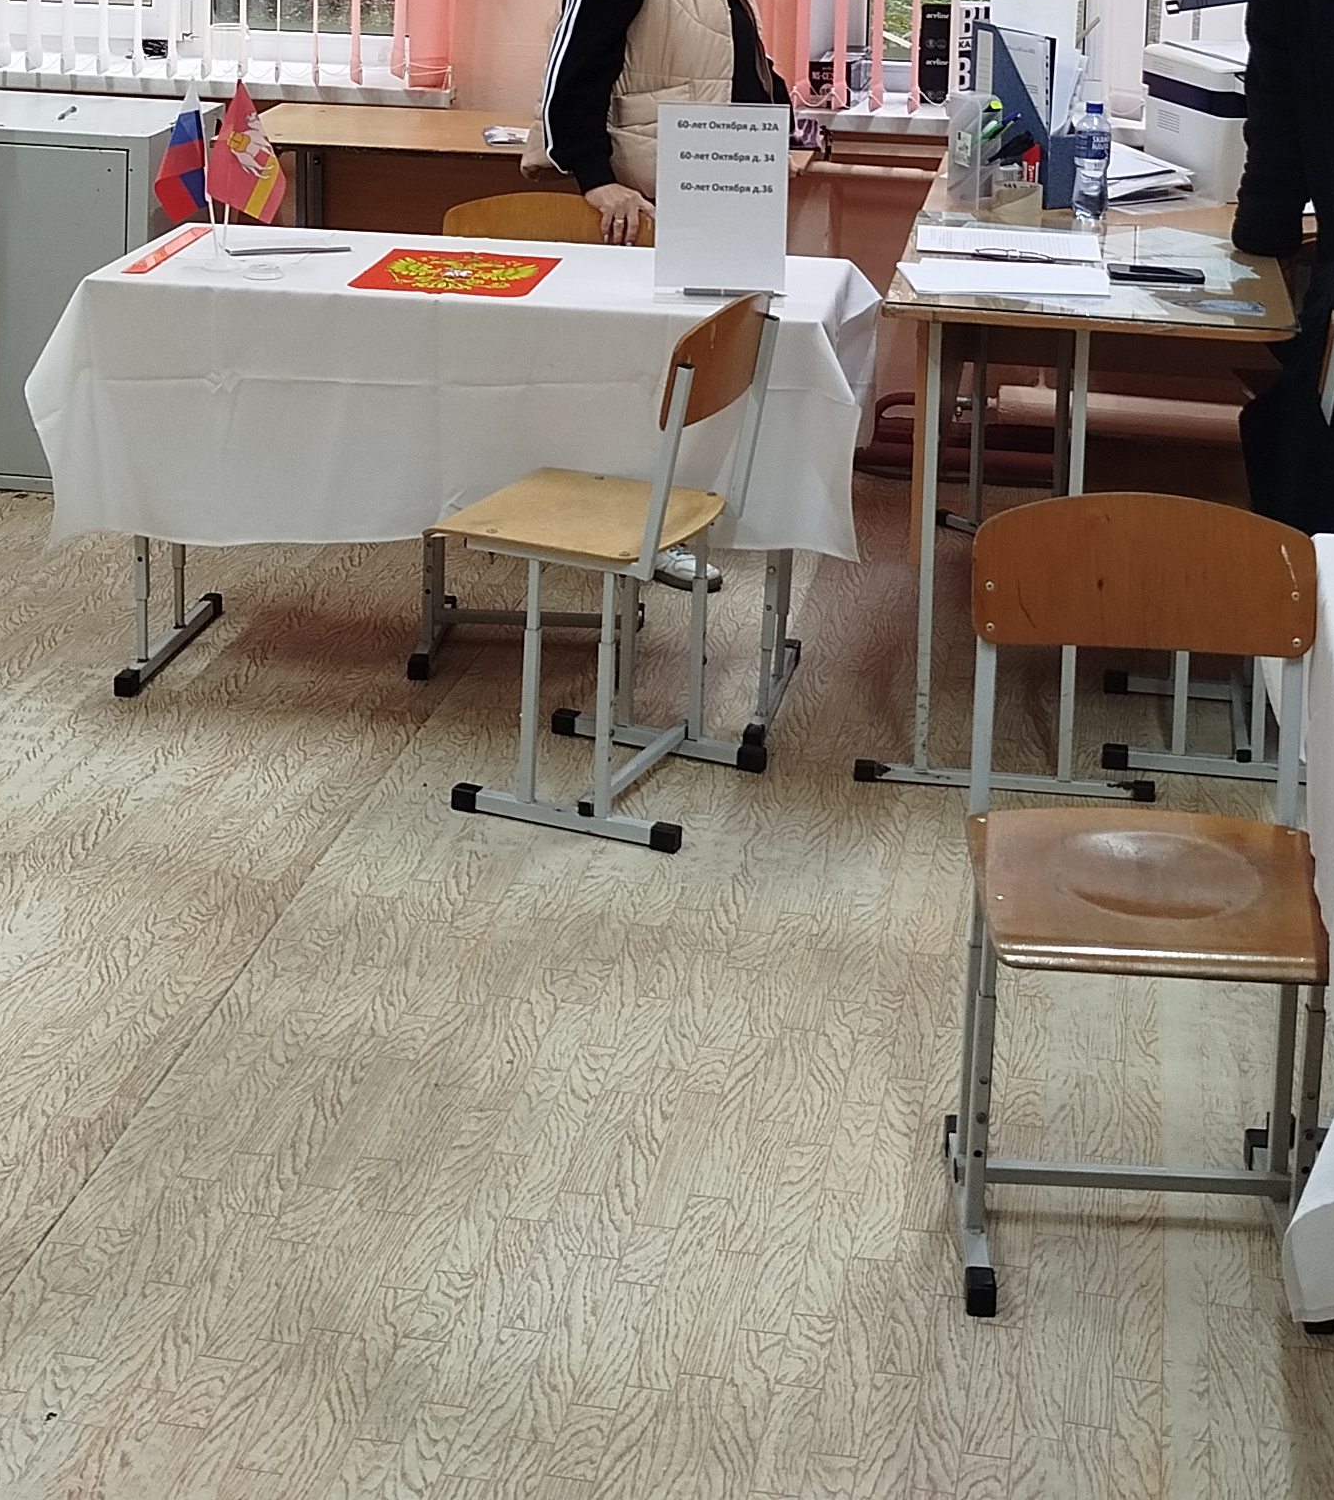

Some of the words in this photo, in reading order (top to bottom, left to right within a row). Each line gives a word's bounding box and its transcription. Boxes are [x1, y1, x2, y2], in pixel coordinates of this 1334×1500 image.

[678, 120, 707, 129] 60-лет
[709, 121, 747, 131] Октября
[749, 123, 759, 131] д.
[680, 151, 709, 160] 60-лет
[711, 152, 750, 163] Октября
[752, 155, 761, 163] д.
[764, 154, 775, 162] 34
[680, 182, 709, 191] 60-лет
[712, 184, 750, 194] Октября
